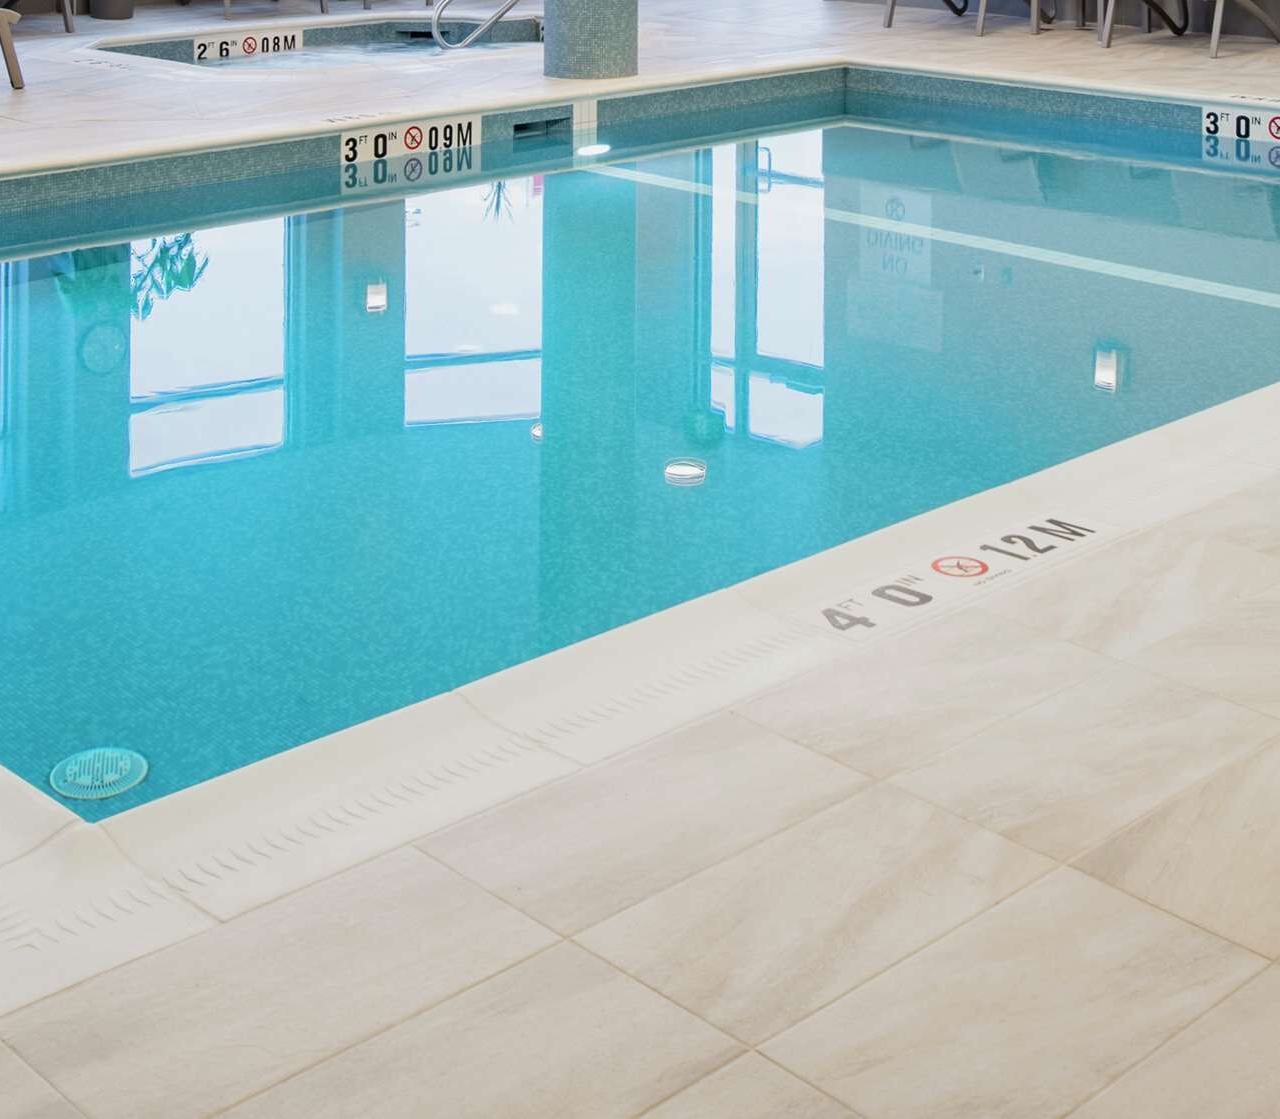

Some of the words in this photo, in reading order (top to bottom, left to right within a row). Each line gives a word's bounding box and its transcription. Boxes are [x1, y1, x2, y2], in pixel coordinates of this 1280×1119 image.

[197, 43, 207, 60] 2
[219, 41, 229, 57] 6
[1205, 112, 1219, 135] 3
[1236, 115, 1250, 139] 0
[345, 137, 358, 162] 3
[373, 133, 387, 158] 0
[822, 607, 877, 631] 4
[871, 584, 933, 607] 0
